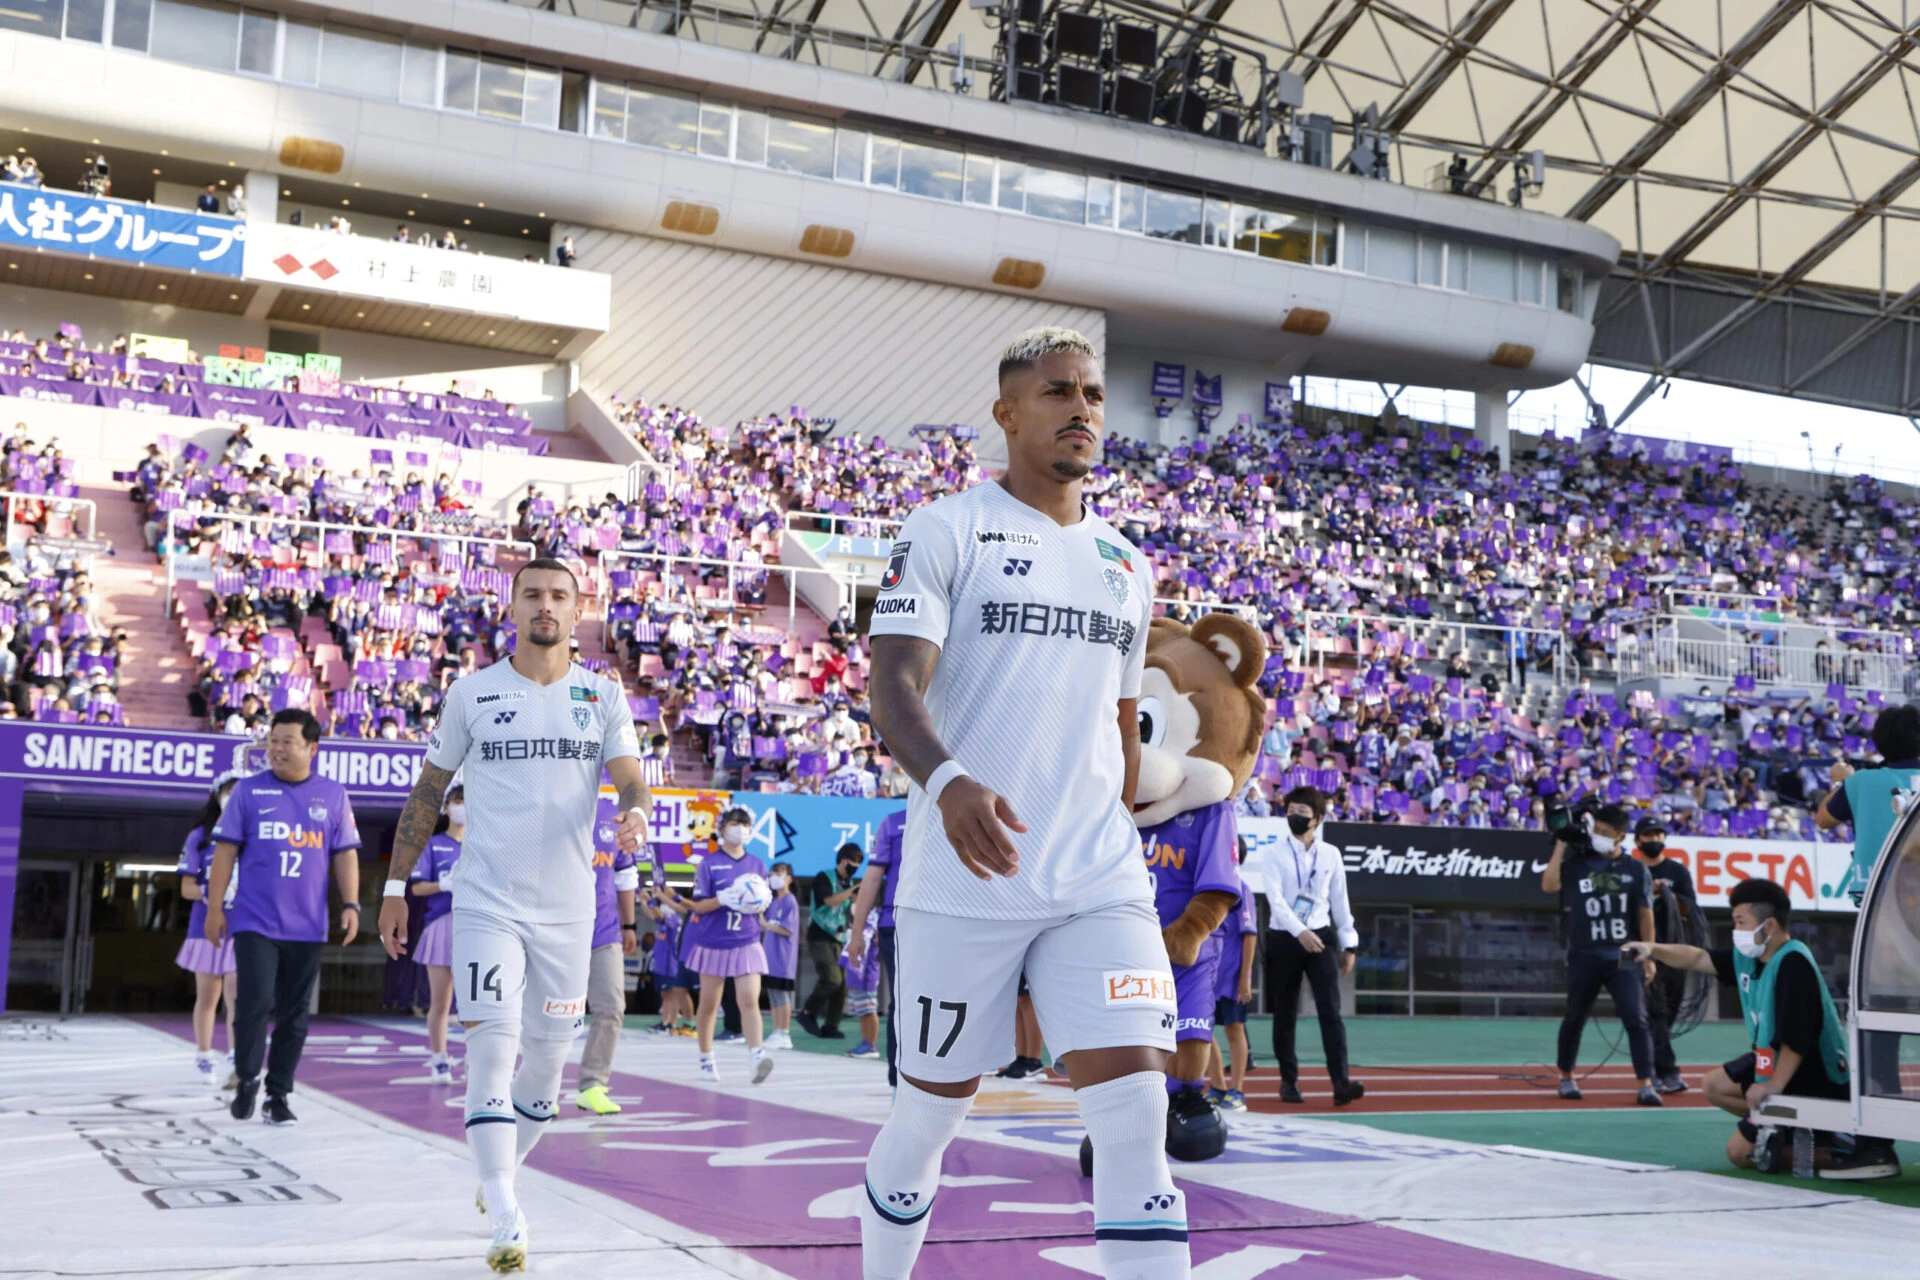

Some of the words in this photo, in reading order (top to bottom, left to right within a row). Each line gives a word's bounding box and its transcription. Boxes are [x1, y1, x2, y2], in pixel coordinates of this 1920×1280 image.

[23, 732, 215, 778] SANFRECCE
[258, 821, 323, 848] EDION
[279, 851, 302, 877] 12
[726, 911, 742, 931] 12
[1591, 918, 1627, 940] HB
[467, 962, 503, 1002] 14
[917, 995, 968, 1058] 17
